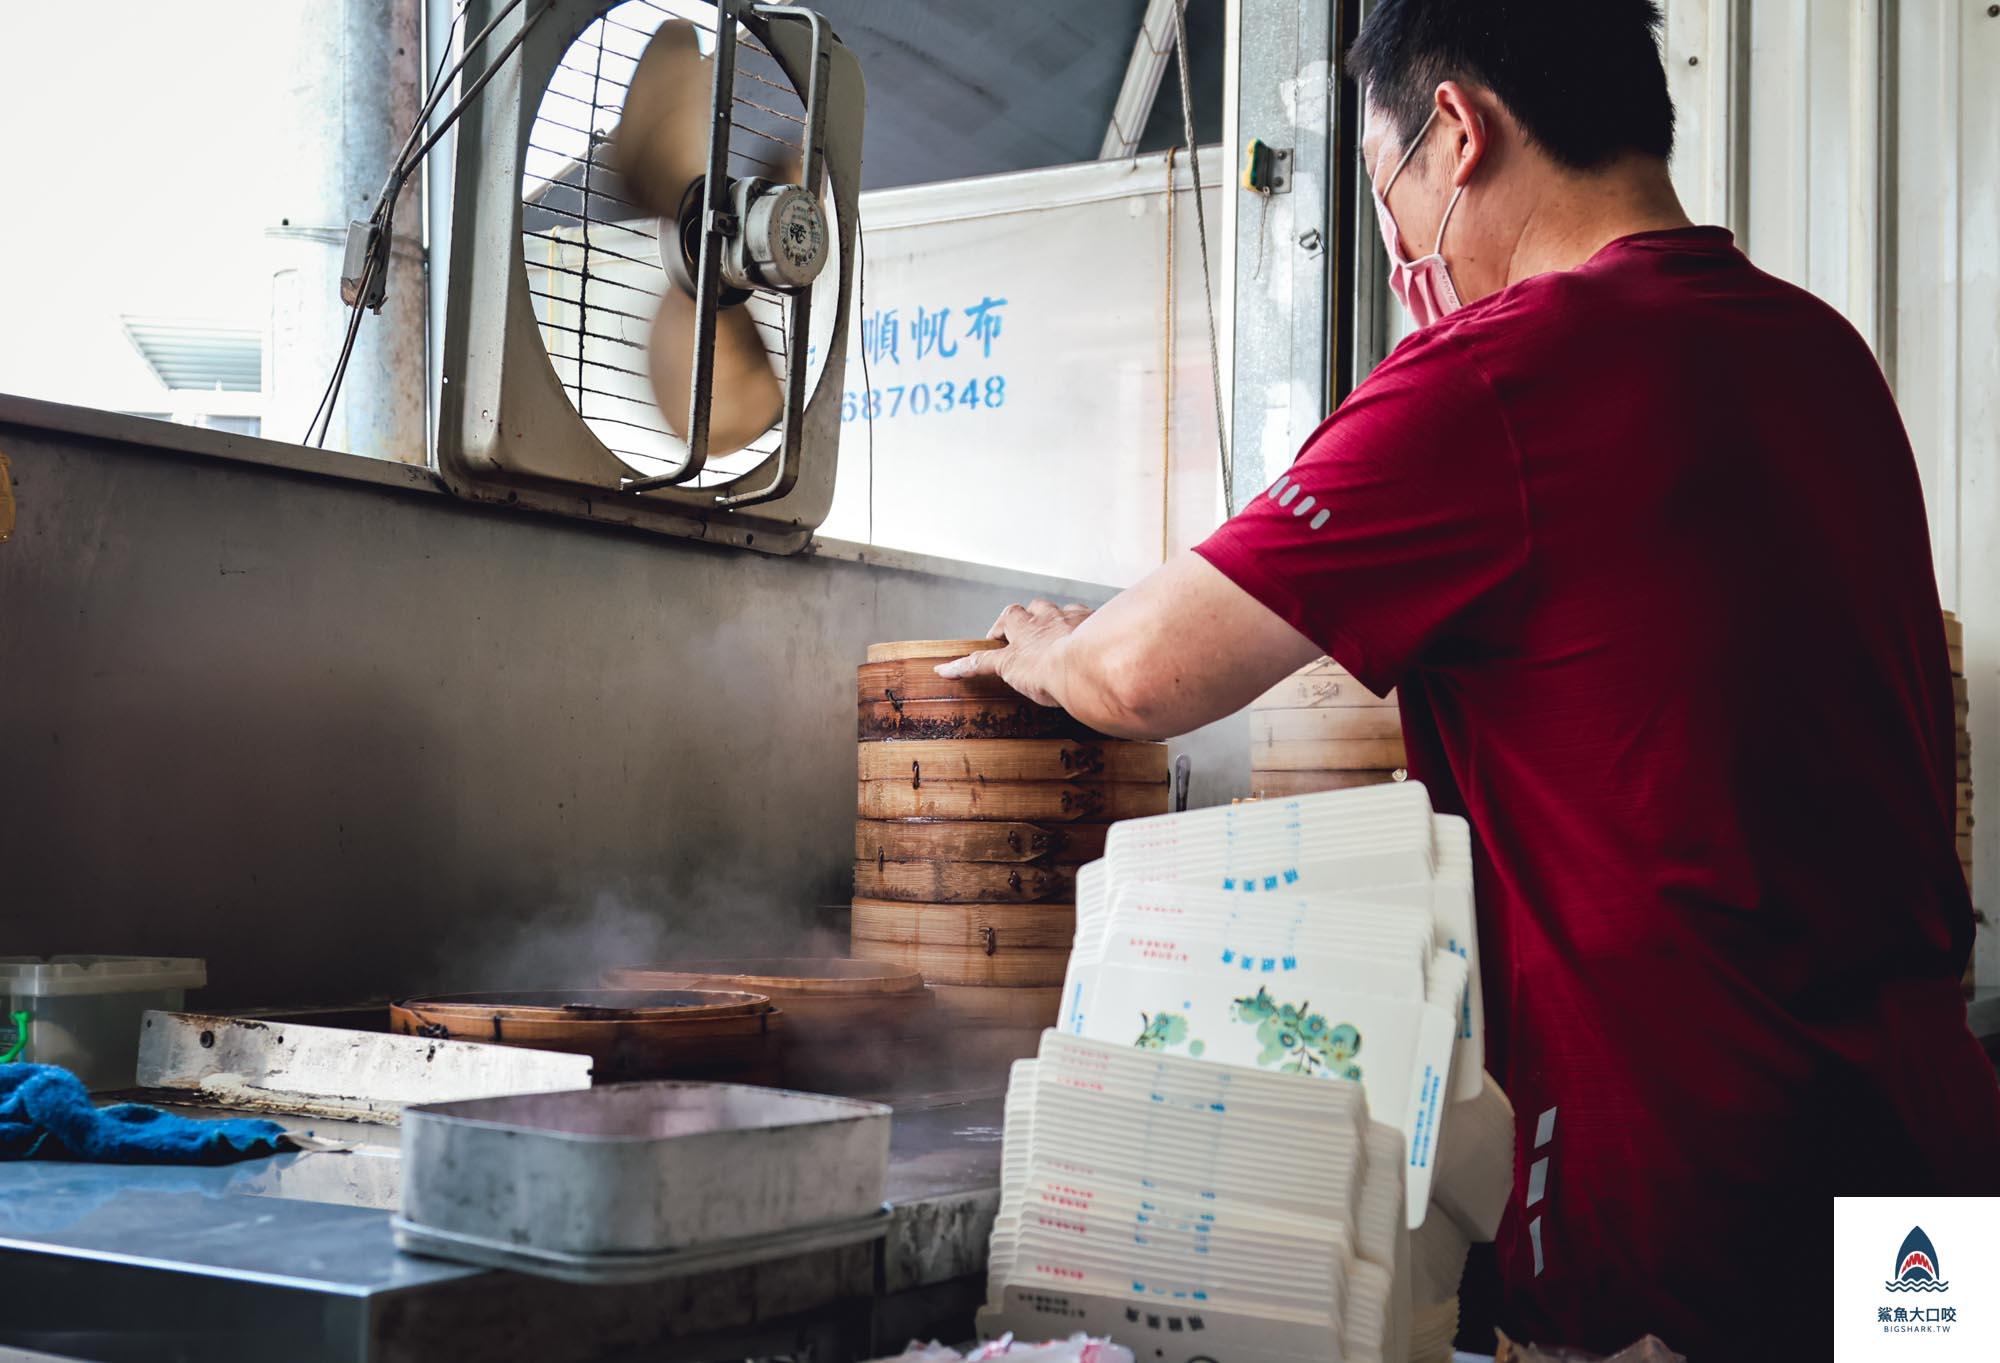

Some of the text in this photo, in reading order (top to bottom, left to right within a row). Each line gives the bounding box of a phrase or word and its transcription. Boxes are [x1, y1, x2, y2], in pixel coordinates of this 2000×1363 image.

[808, 297, 1008, 366] 順帆布
[841, 375, 1006, 422] 6870348
